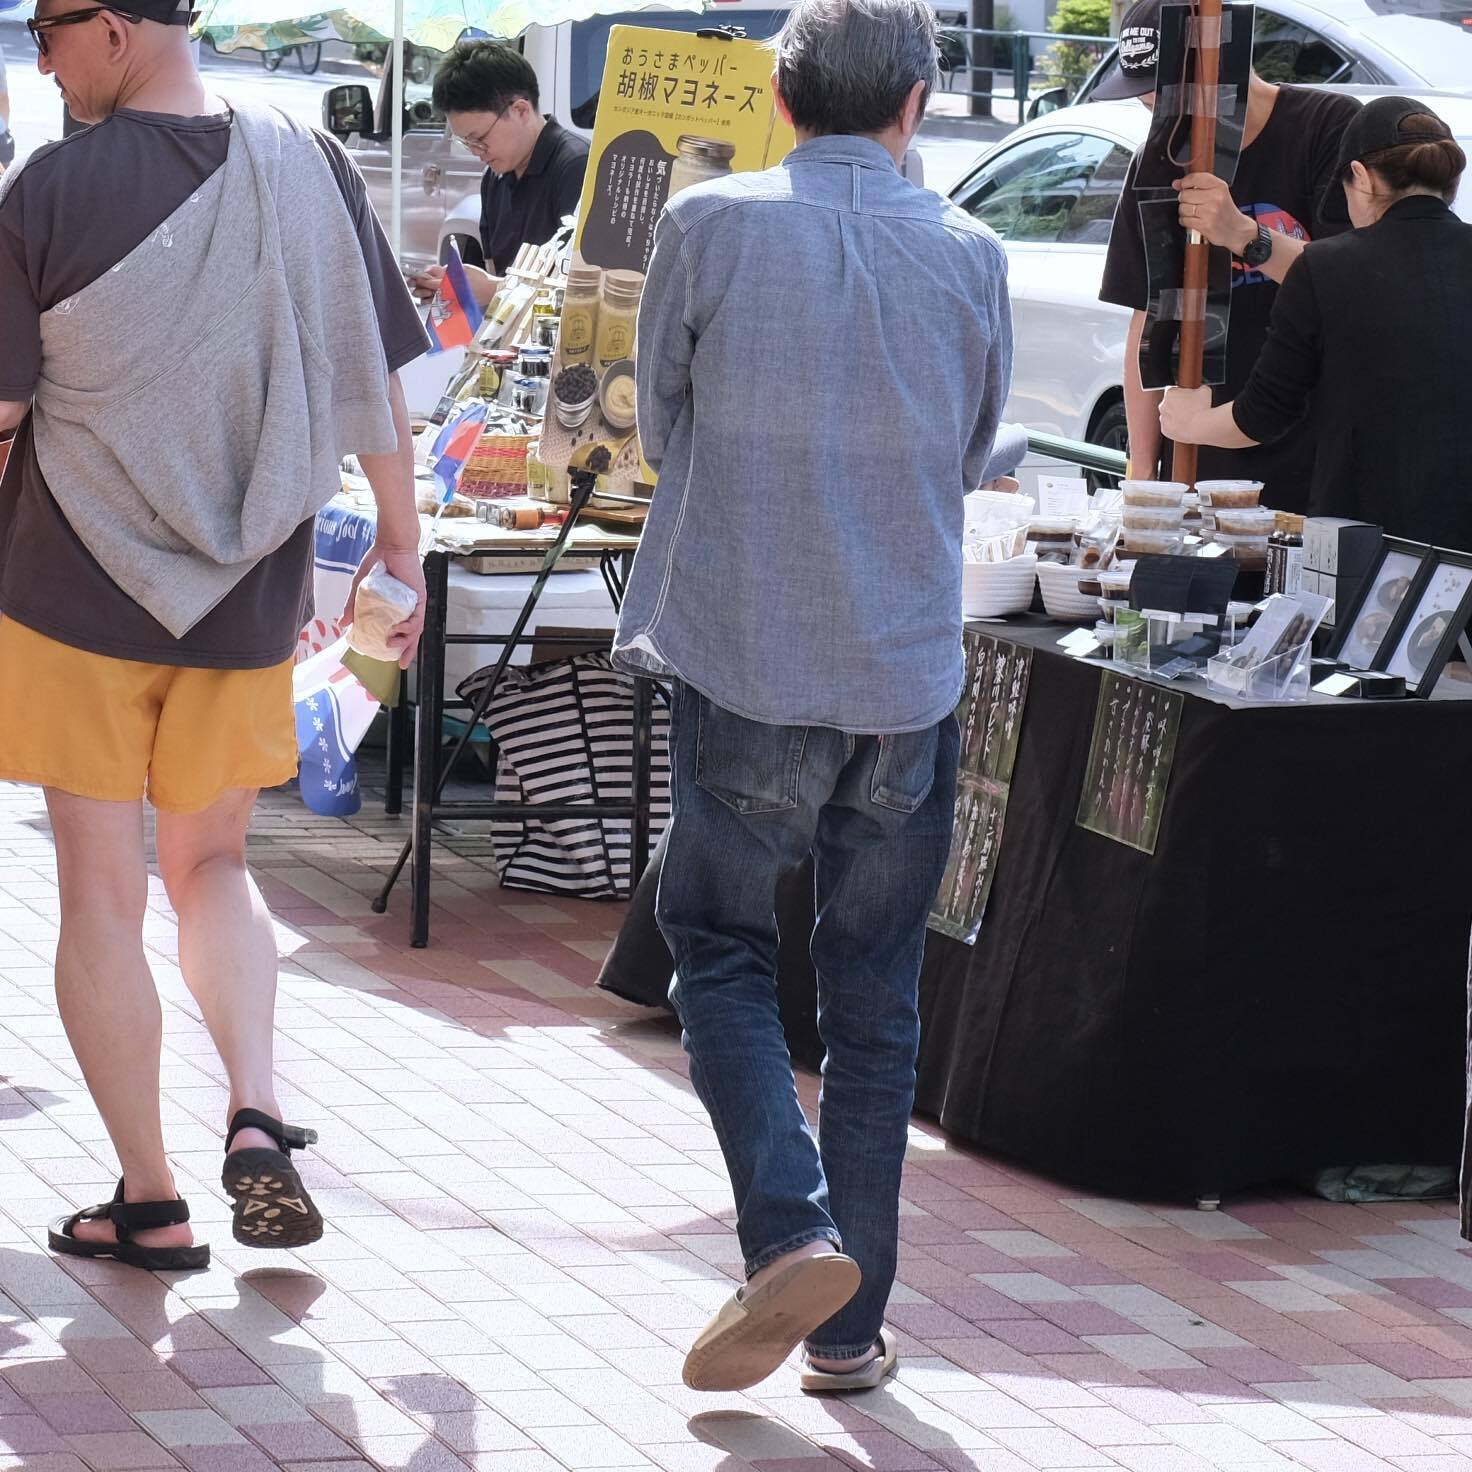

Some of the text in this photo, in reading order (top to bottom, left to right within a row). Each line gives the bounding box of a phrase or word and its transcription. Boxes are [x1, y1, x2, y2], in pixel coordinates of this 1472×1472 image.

[1140, 27, 1154, 37] OUT
[622, 47, 738, 77] おうさまペッパー
[616, 69, 763, 113] 胡椒マヨネーズ
